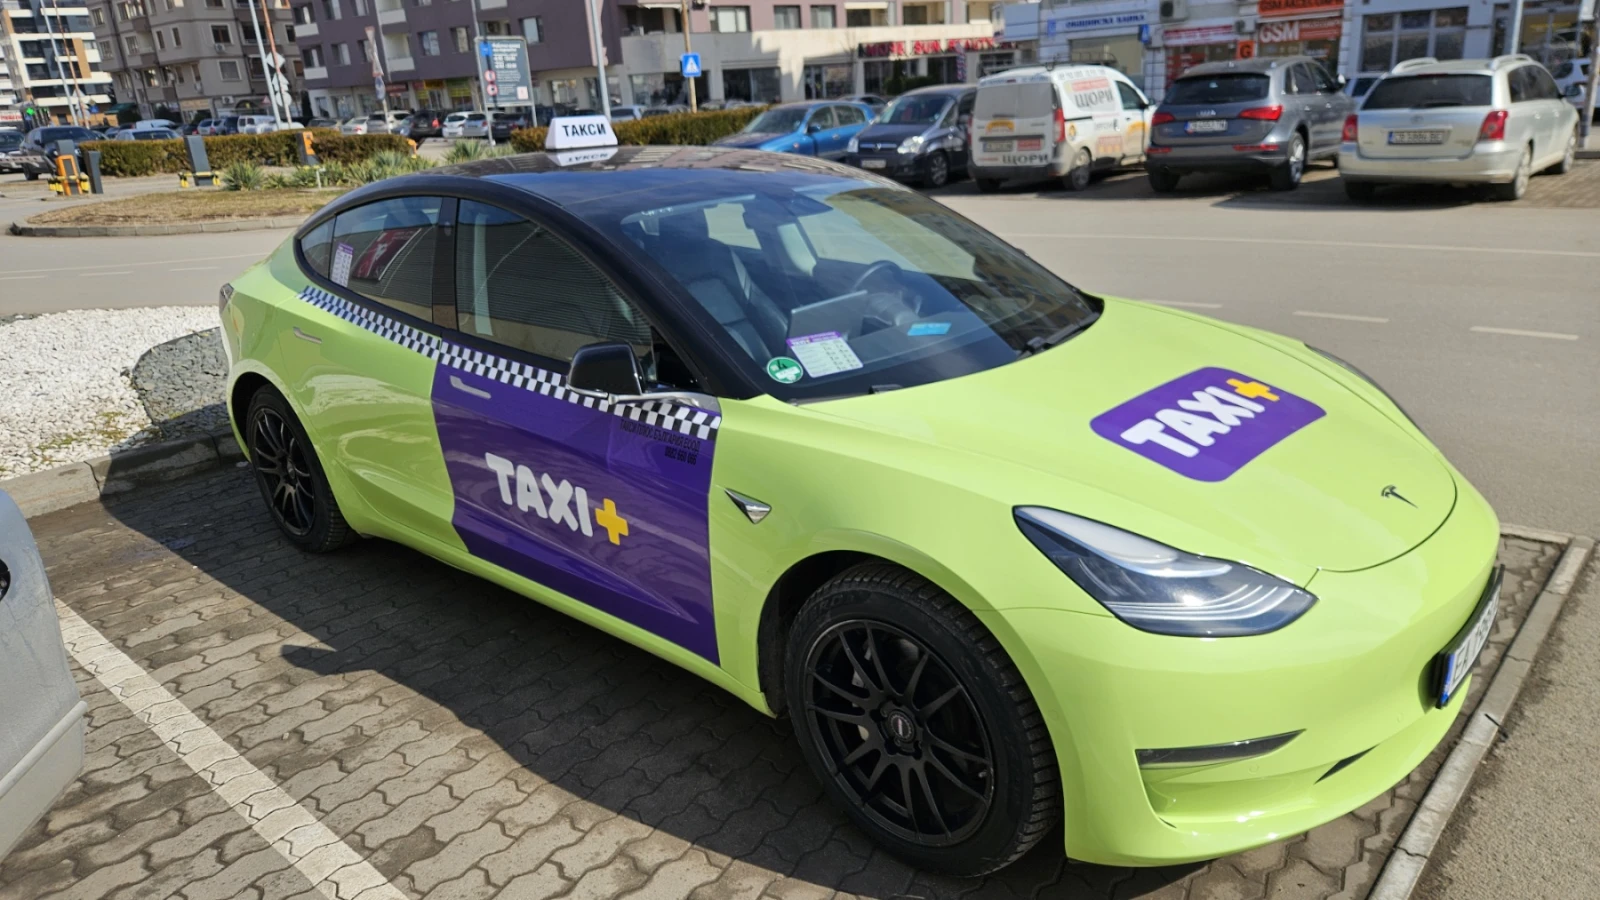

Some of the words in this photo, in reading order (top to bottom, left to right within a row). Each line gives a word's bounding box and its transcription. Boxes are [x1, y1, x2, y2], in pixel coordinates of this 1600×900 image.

[1259, 21, 1299, 43] GSM
[1240, 45, 1251, 58] G
[1074, 89, 1114, 108] ЩОРИ
[562, 123, 606, 137] ТАКСИ
[1002, 154, 1049, 165] ЩОРИ
[1119, 378, 1281, 458] TAXI+
[485, 452, 629, 545] TAXI+
